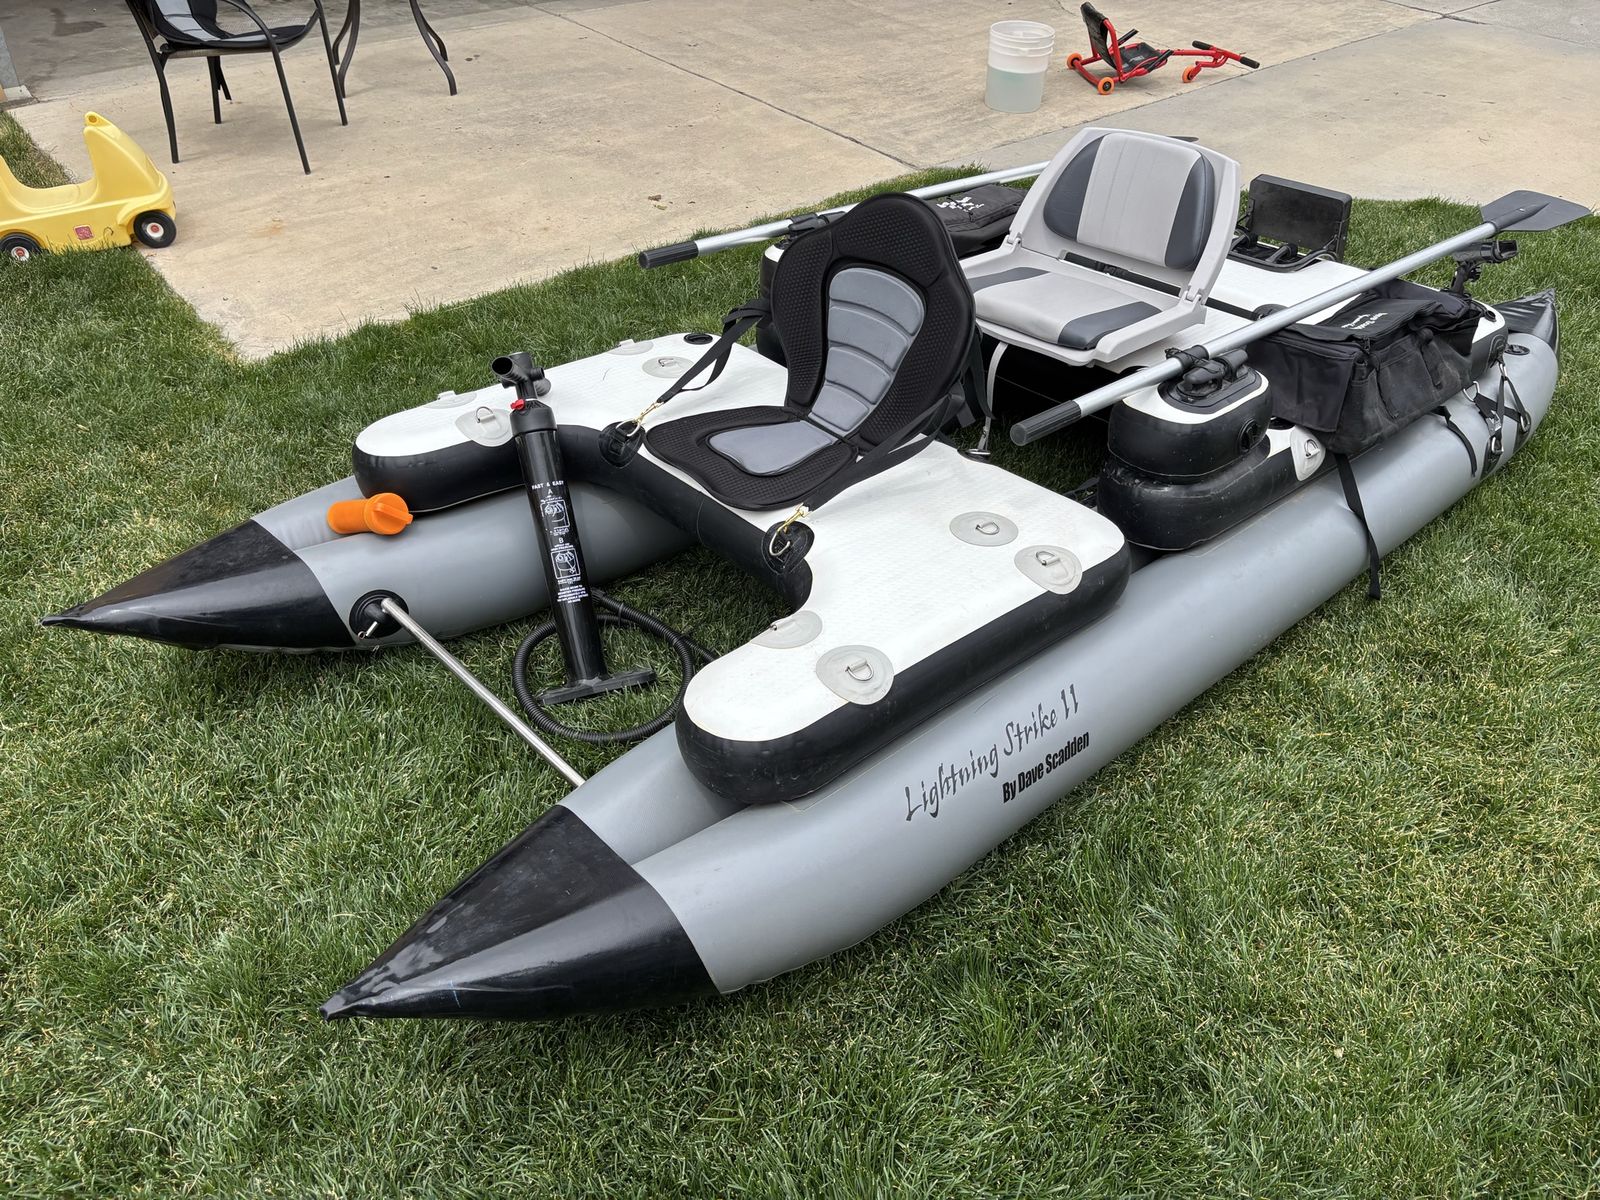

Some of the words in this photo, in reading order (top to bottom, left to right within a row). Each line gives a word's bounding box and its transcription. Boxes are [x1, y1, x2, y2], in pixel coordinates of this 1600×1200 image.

[904, 743, 999, 821] Lightning
[1003, 702, 1058, 756] Strike
[1002, 780, 1017, 803] By
[1018, 763, 1044, 793] Dave
[1045, 731, 1090, 775] Scadden
